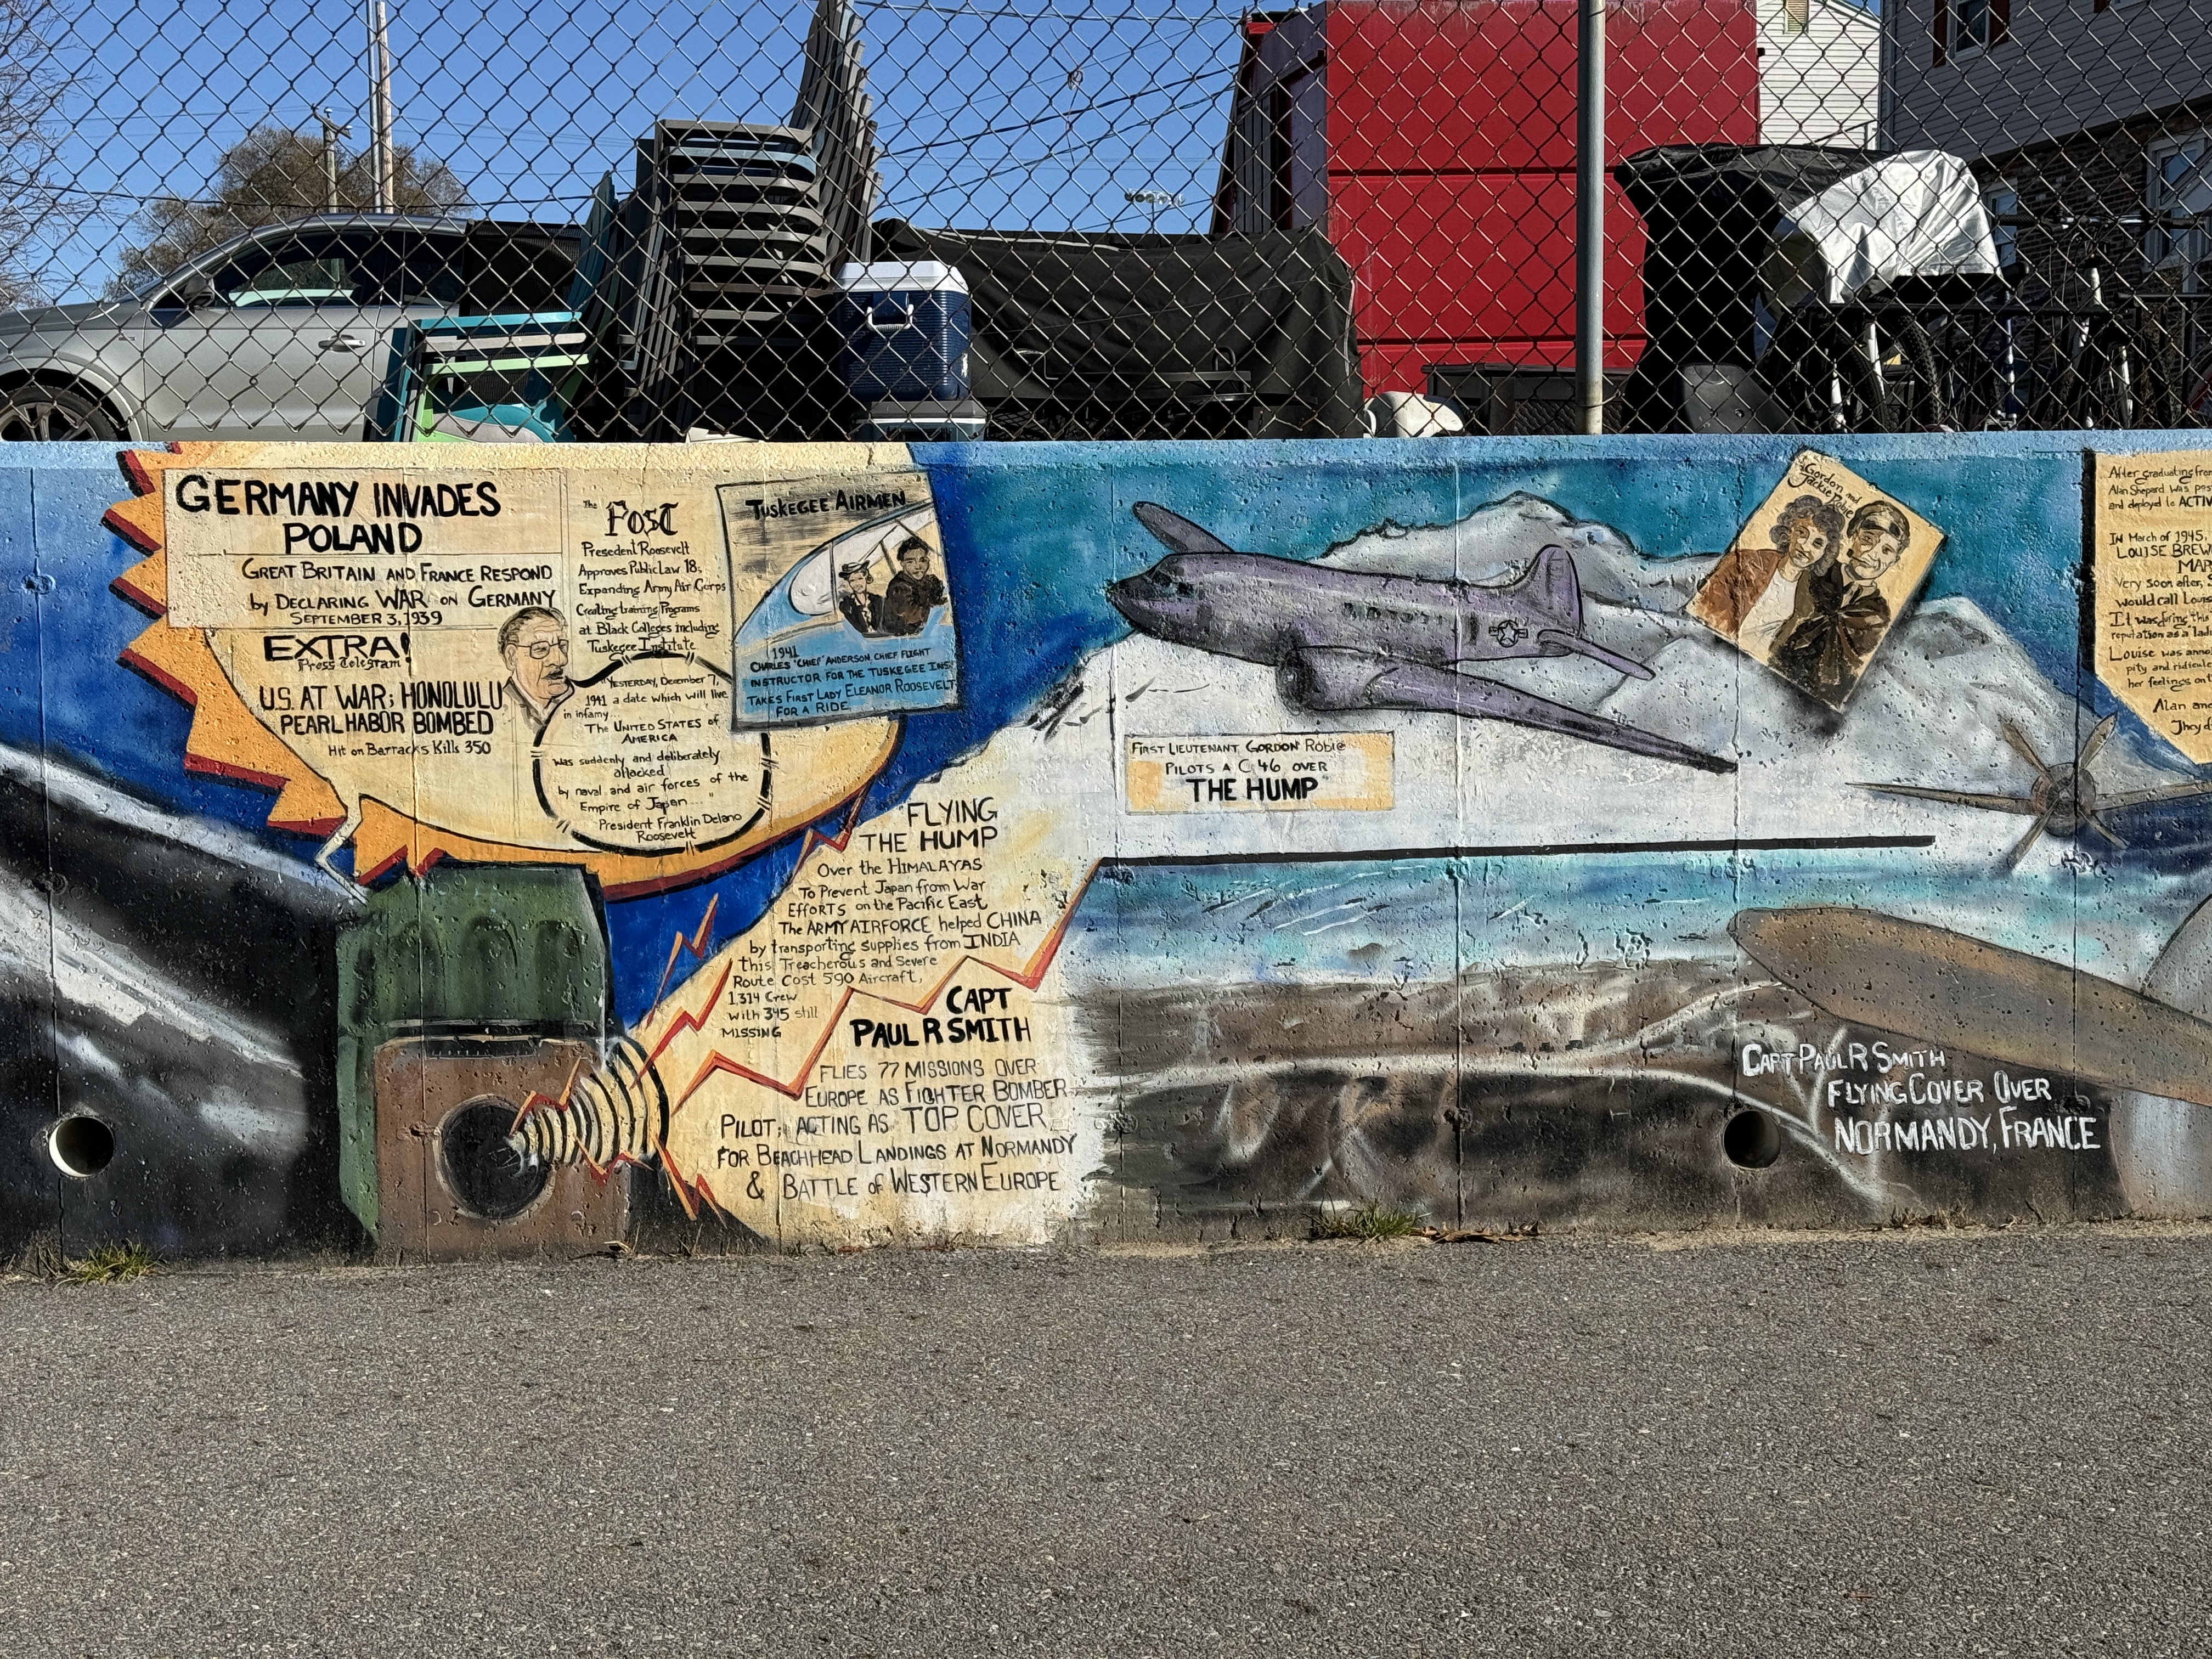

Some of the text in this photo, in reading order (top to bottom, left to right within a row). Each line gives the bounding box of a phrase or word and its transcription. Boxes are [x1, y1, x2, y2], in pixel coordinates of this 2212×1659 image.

[176, 474, 501, 517] GERMANY INVADES
[1787, 471, 1854, 519] Jackie Robie
[1803, 463, 1863, 505] Gordon and
[745, 489, 906, 520] TUSKEGEE AIRMEN
[284, 522, 422, 554] POLAND
[2129, 532, 2157, 542] March
[2160, 531, 2171, 542] of
[241, 557, 553, 583] GREAT BRITAIN AND FRANCE RESPOND
[579, 578, 726, 599] Expanding Army Air Corps
[2114, 577, 2141, 592] Very
[2147, 579, 2173, 588] soon
[250, 593, 269, 616] by
[275, 592, 369, 610] DECLARING
[376, 589, 427, 610] WAR
[467, 586, 555, 608] GERMANY
[2115, 593, 2178, 608] would call
[291, 611, 383, 626] SEPTEMBER
[579, 620, 720, 639] at Black Colleges including
[264, 632, 411, 667] EXTRA!
[638, 637, 697, 652] Institute
[771, 645, 800, 659] 1941
[750, 661, 791, 672] CHARLES
[874, 652, 898, 661] CHIEF
[901, 647, 931, 658] FLIGHT
[2126, 661, 2169, 675] pity and
[661, 676, 706, 686] December
[707, 675, 720, 686] 7,
[751, 673, 821, 688] INSTRUCTOR
[826, 670, 844, 680] FOR
[849, 670, 865, 679] THE
[868, 664, 926, 678] TUSKEGEE
[2128, 677, 2192, 691] her feelings
[301, 685, 328, 710] AT
[400, 680, 504, 710] HONOLULU
[747, 679, 956, 706] TAKES FIRST LADY ELEANOR ROOSEVELT
[776, 706, 798, 717] FOR
[802, 706, 809, 714] A
[2153, 698, 2186, 713] Alan
[280, 713, 345, 735] PEARL
[413, 712, 494, 735] BOMBED
[584, 715, 719, 734] The UNITED STATES of
[328, 740, 492, 757] Hit on Barracks Kills 350
[622, 733, 678, 744] AMERICA
[1132, 742, 1166, 755] FIRST
[1169, 743, 1237, 756] LIEUTENANT
[1246, 741, 1300, 752] GORDON
[1166, 762, 1215, 775] PILOTS
[1293, 761, 1328, 772] OVER
[1186, 777, 1318, 802] THE HUMP
[600, 812, 742, 831] President Franklin Delano
[907, 797, 998, 827] FLYING
[636, 830, 697, 844] Roosevelt
[859, 826, 998, 853] THE HUMP
[817, 858, 983, 877] Over the HIMALAYAS
[778, 921, 803, 935] The
[807, 921, 848, 935] ARMY
[939, 916, 982, 937] helped
[986, 910, 1042, 929] CHINA
[946, 986, 1013, 1015] CAPT
[850, 1017, 1031, 1048] PAUL R SMITH
[820, 1058, 1037, 1082] FLIES 77 MISSIONS OVER
[1742, 1042, 1946, 1077] CAPT PAUL R SMITH
[805, 1079, 1068, 1108] EUROPE AS FIGHTER BOMBER
[1828, 1070, 2052, 1109] FLYING COVER OVER
[796, 1114, 861, 1136] ACTING
[868, 1114, 889, 1133] AS
[901, 1106, 959, 1133] TOP
[967, 1103, 1047, 1131] COVER
[1835, 1104, 2102, 1155] NORMANDY, FRANCE
[718, 1133, 1077, 1170] FOR BEACHHEAD LANDINGS AT NORMANDY
[746, 1171, 765, 1199] &
[783, 1174, 857, 1201] BATTLE
[891, 1166, 978, 1196] WESTERN
[981, 1161, 1060, 1191] EUROPE
